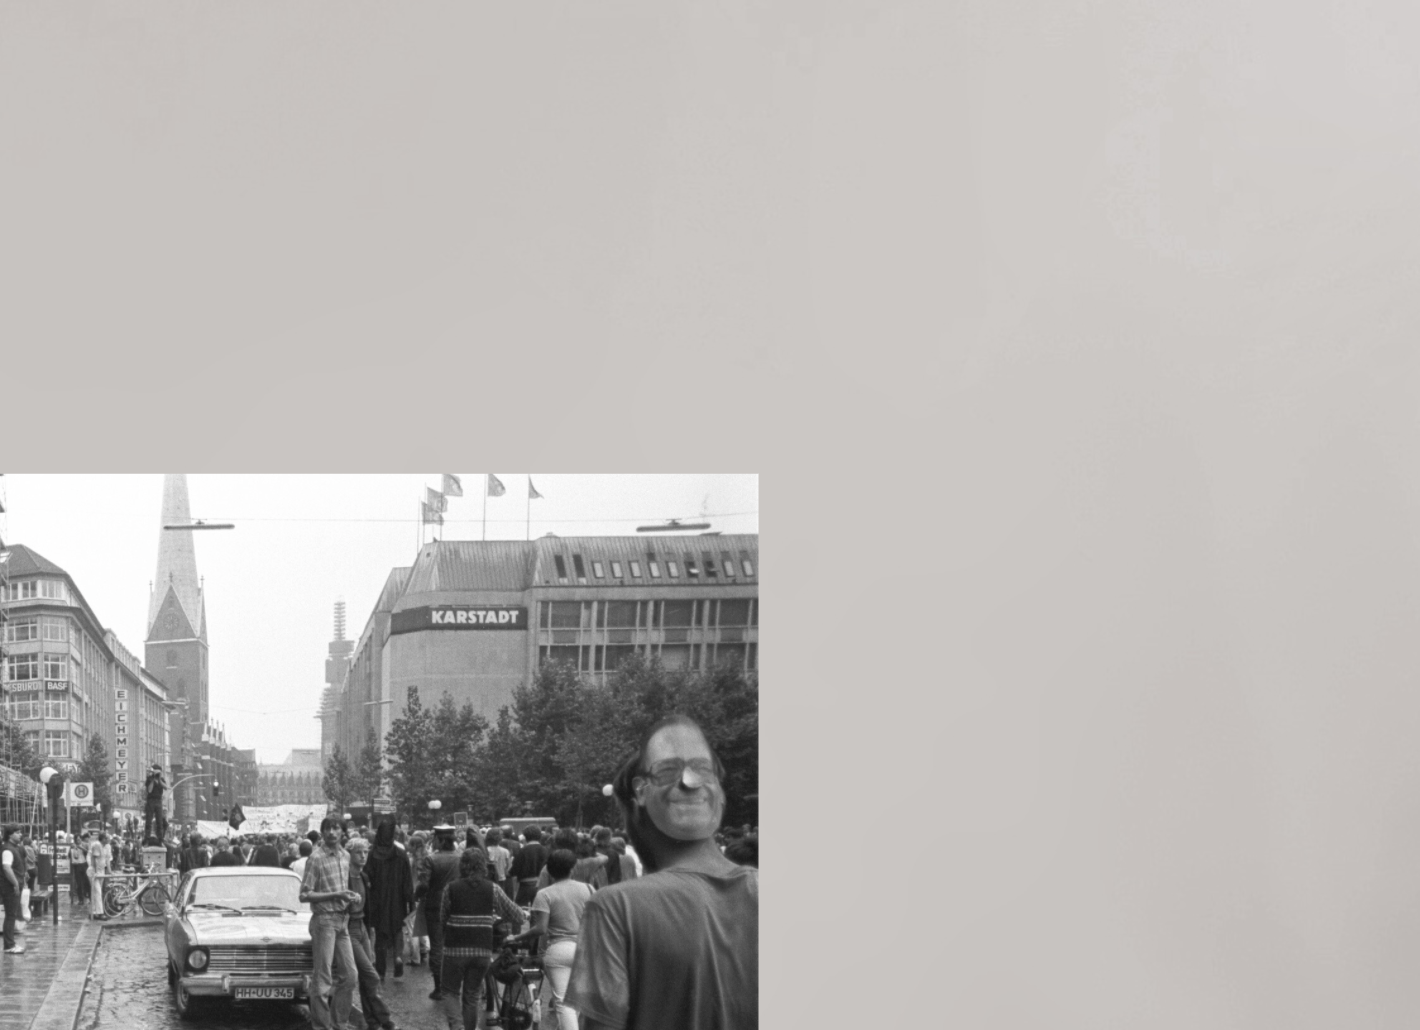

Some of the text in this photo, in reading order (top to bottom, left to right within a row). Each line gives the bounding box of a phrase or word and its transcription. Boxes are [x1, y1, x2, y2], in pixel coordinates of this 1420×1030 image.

[432, 610, 519, 624] KARSTADT
[47, 681, 68, 690] BASF
[117, 690, 126, 792] EICHMEYER
[273, 988, 293, 998] 345
